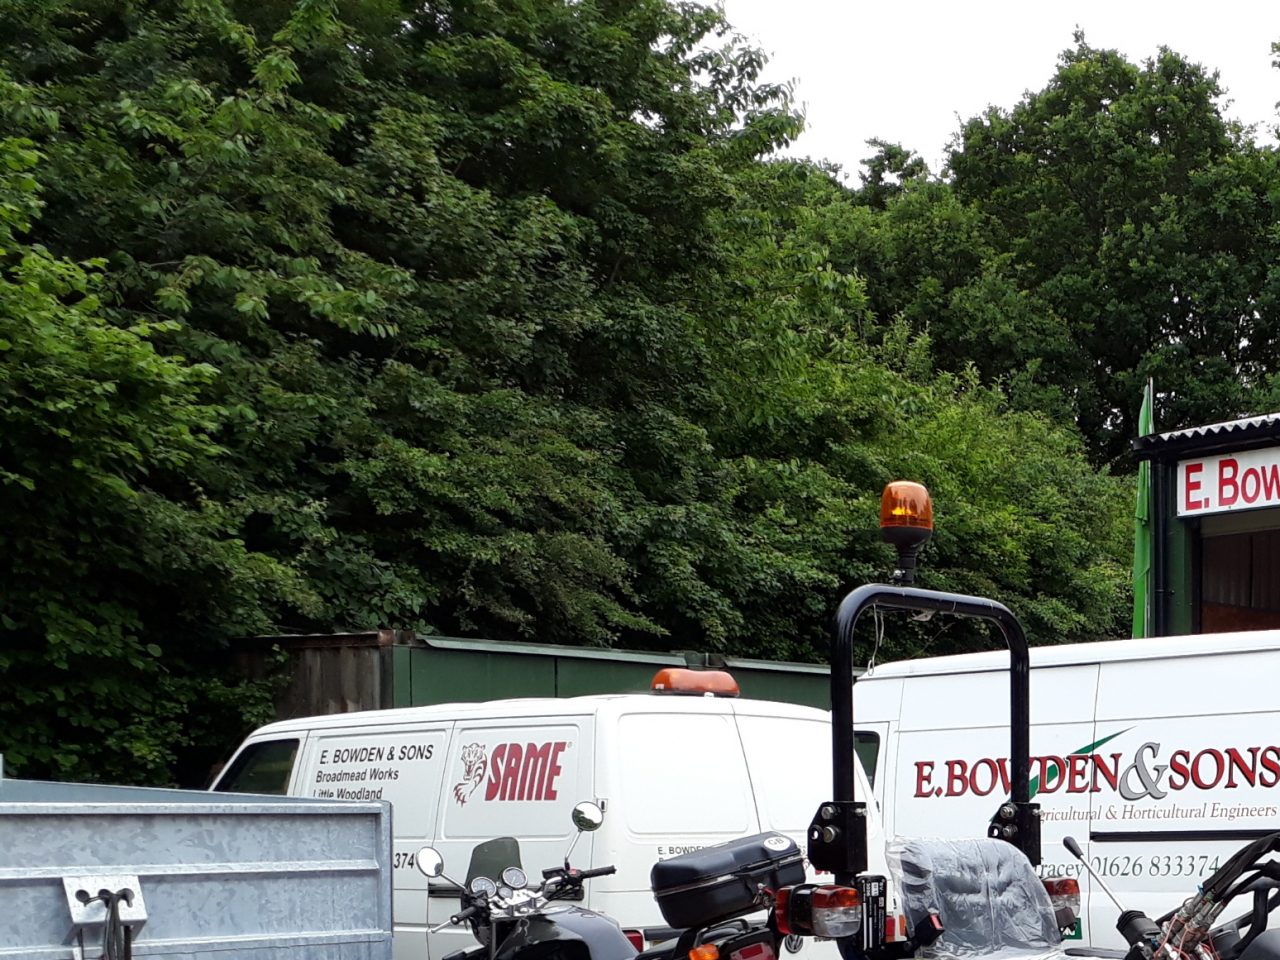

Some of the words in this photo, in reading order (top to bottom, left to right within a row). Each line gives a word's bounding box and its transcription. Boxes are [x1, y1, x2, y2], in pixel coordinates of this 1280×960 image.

[1186, 463, 1210, 511] E.
[320, 750, 329, 764] E.
[333, 747, 385, 763] BOWDEN
[387, 746, 395, 761] &
[398, 744, 434, 760] SONS
[315, 768, 367, 783] Broadmead
[369, 768, 399, 781] Works
[485, 742, 567, 800] SAME
[337, 786, 383, 800] Woodland
[1039, 806, 1101, 823] gricultural
[1105, 806, 1118, 820] &
[1122, 804, 1206, 820] Horticultural
[1210, 802, 1278, 819] Engineers
[669, 846, 705, 855] BOWDE
[1035, 857, 1085, 880] racey
[1149, 854, 1221, 877] 833374
